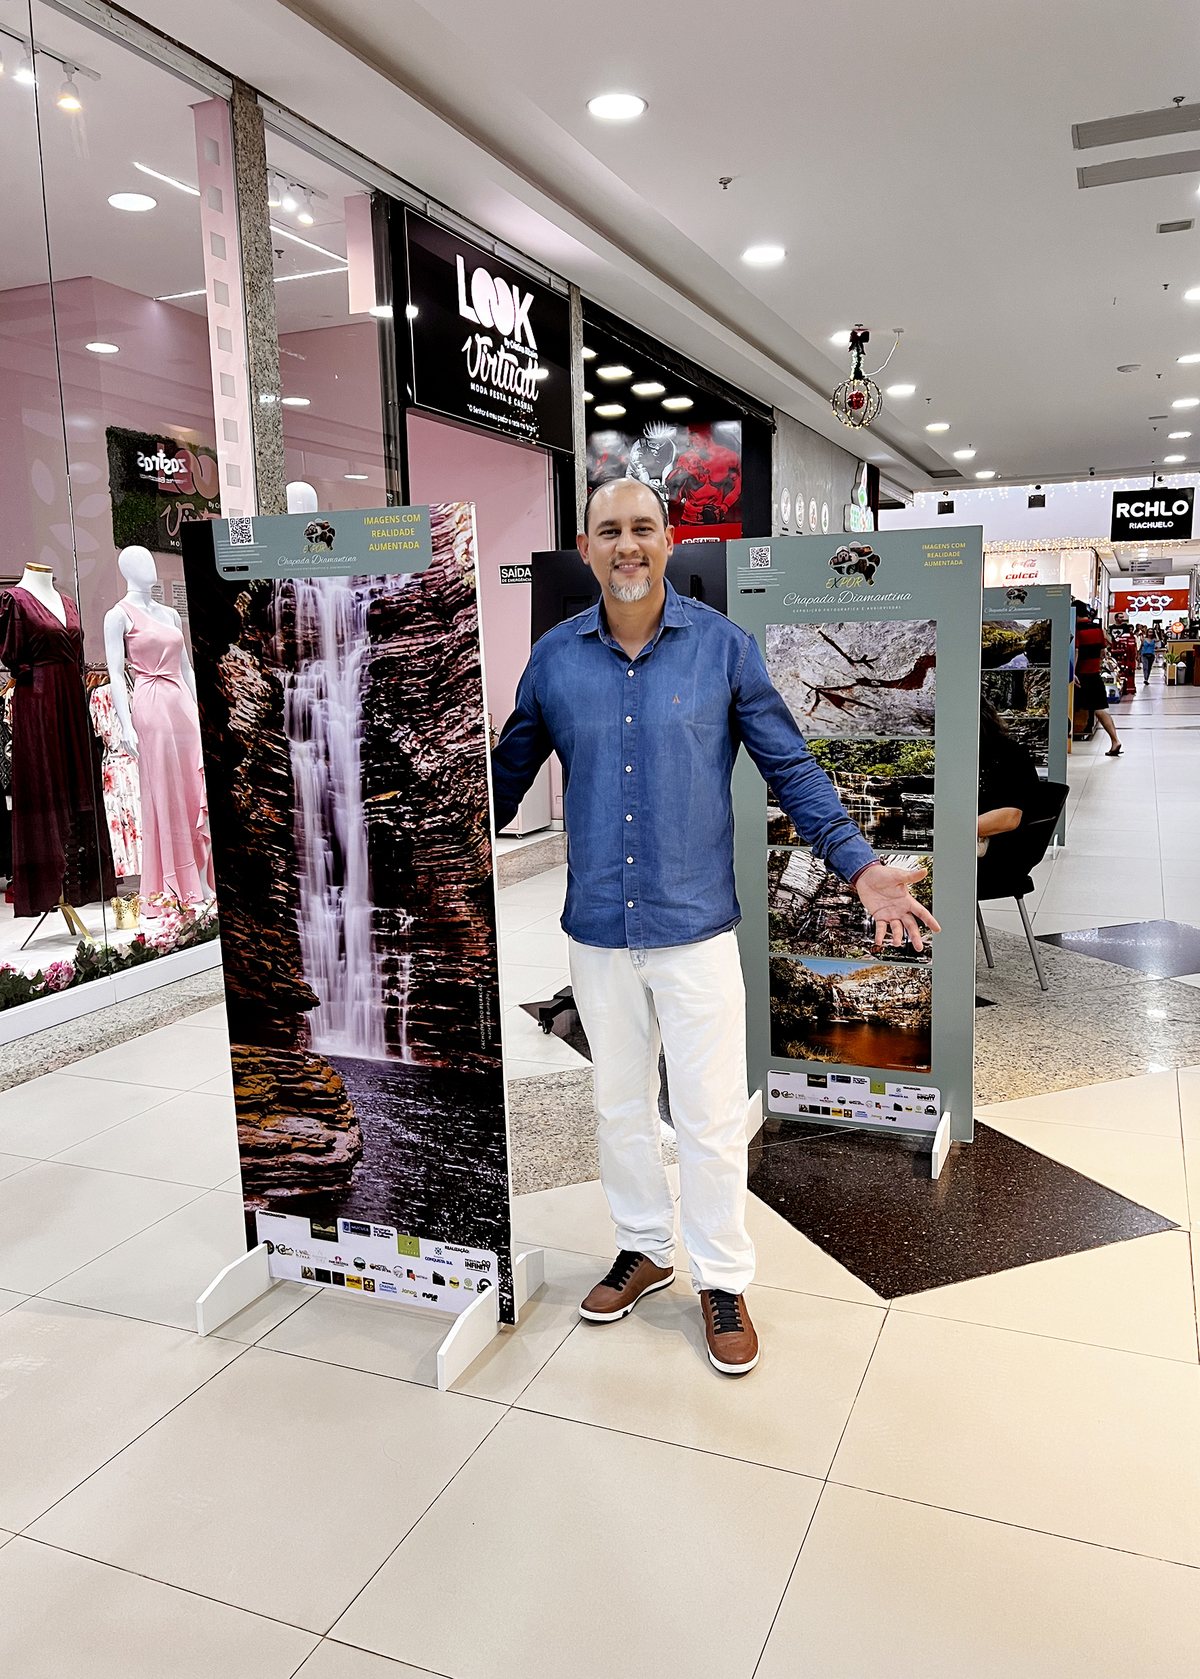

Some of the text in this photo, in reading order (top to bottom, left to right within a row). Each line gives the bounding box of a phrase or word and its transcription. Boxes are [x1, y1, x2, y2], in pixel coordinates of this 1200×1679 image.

[456, 253, 537, 351] LOOK
[470, 382, 488, 396] MODA
[489, 389, 507, 403] FESTA
[513, 398, 534, 413] CASUAL
[1116, 500, 1189, 518] RCHLO
[364, 514, 421, 525] IMAGENS COM
[1129, 521, 1174, 529] RIACHUELO
[371, 528, 415, 538] REALIDADE
[369, 541, 420, 551] AUMENTADA
[277, 554, 357, 567] Chapada Diamantina
[924, 559, 963, 567] AUMENTADA
[501, 566, 532, 578] SAÍDA
[783, 590, 913, 607] Chapada Diamantina
